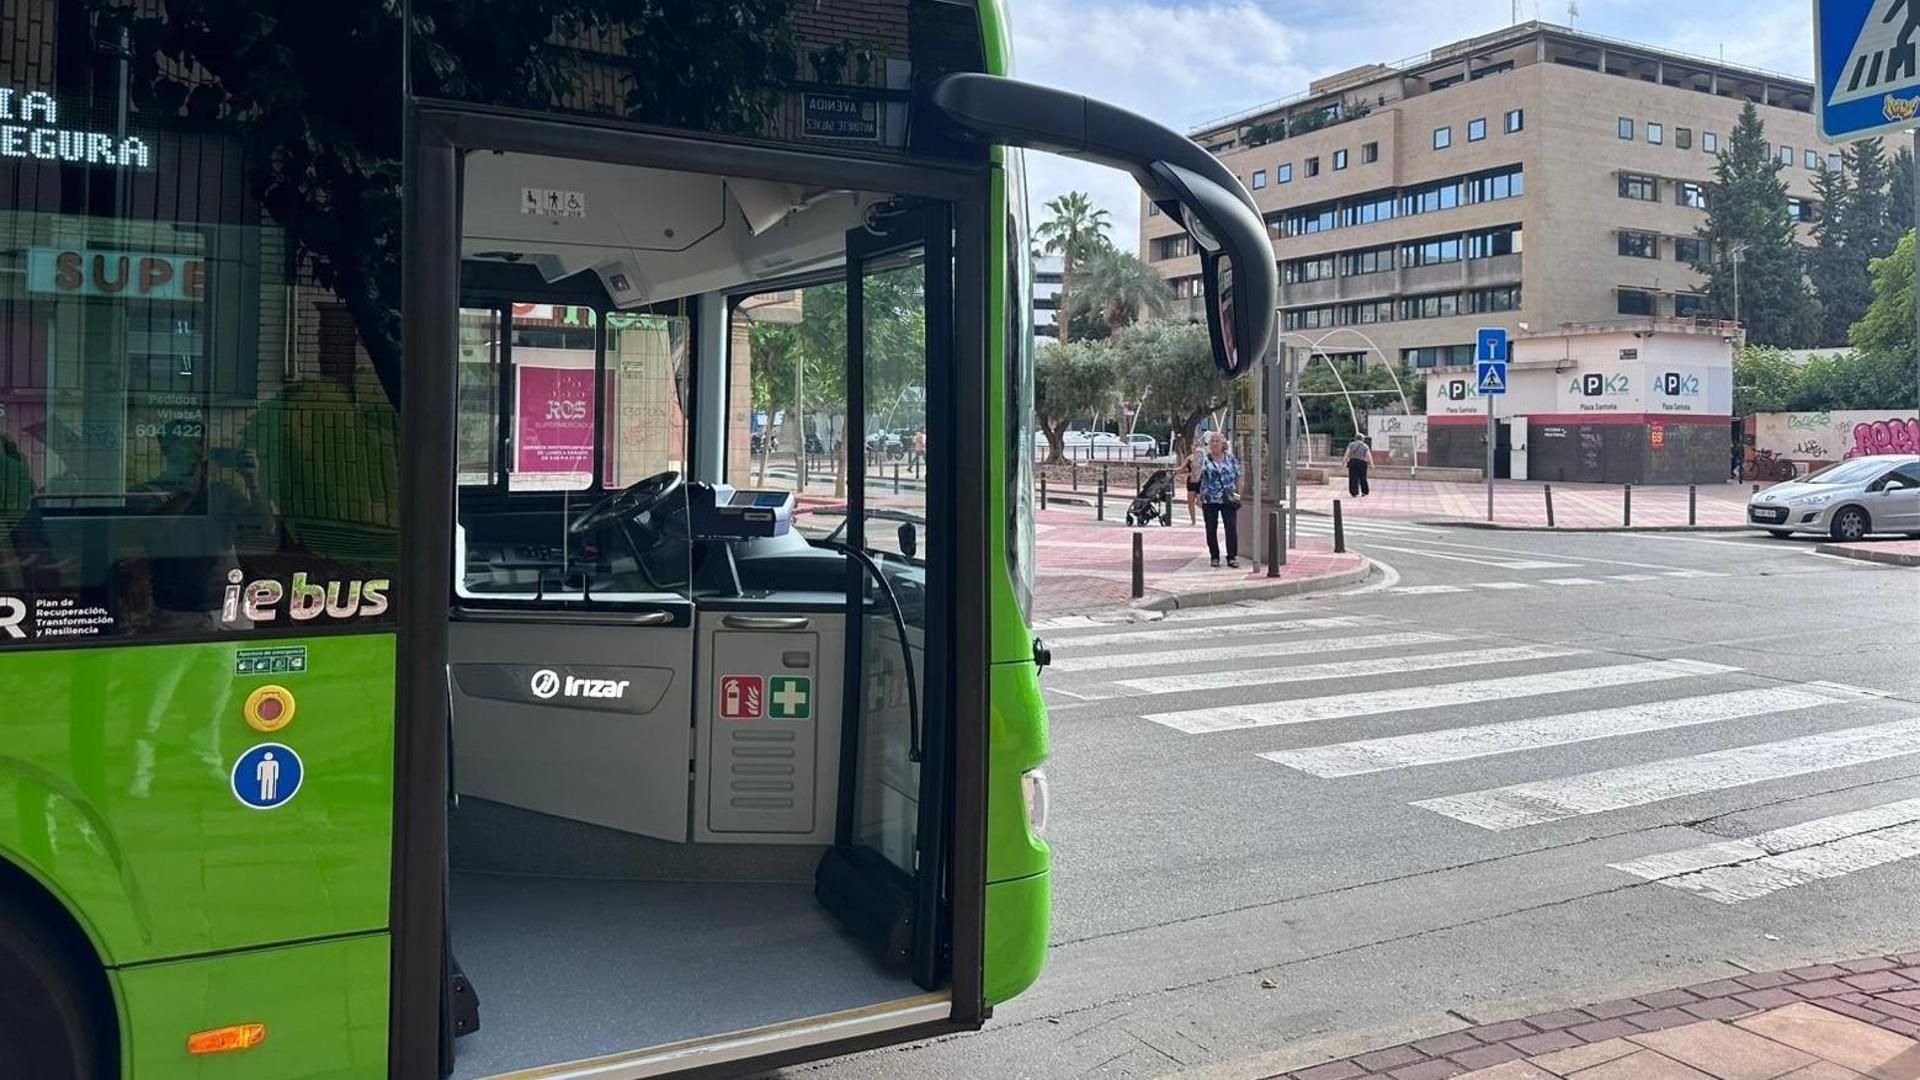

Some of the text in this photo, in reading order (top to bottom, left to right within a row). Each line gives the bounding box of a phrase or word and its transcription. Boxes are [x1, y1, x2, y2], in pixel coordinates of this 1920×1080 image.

[2, 125, 149, 168] EGURA
[546, 400, 586, 420] ROS
[61, 598, 73, 606] de
[36, 607, 108, 617] Recuperación,
[36, 616, 114, 626] Transformación
[45, 626, 99, 635] Resiliencia
